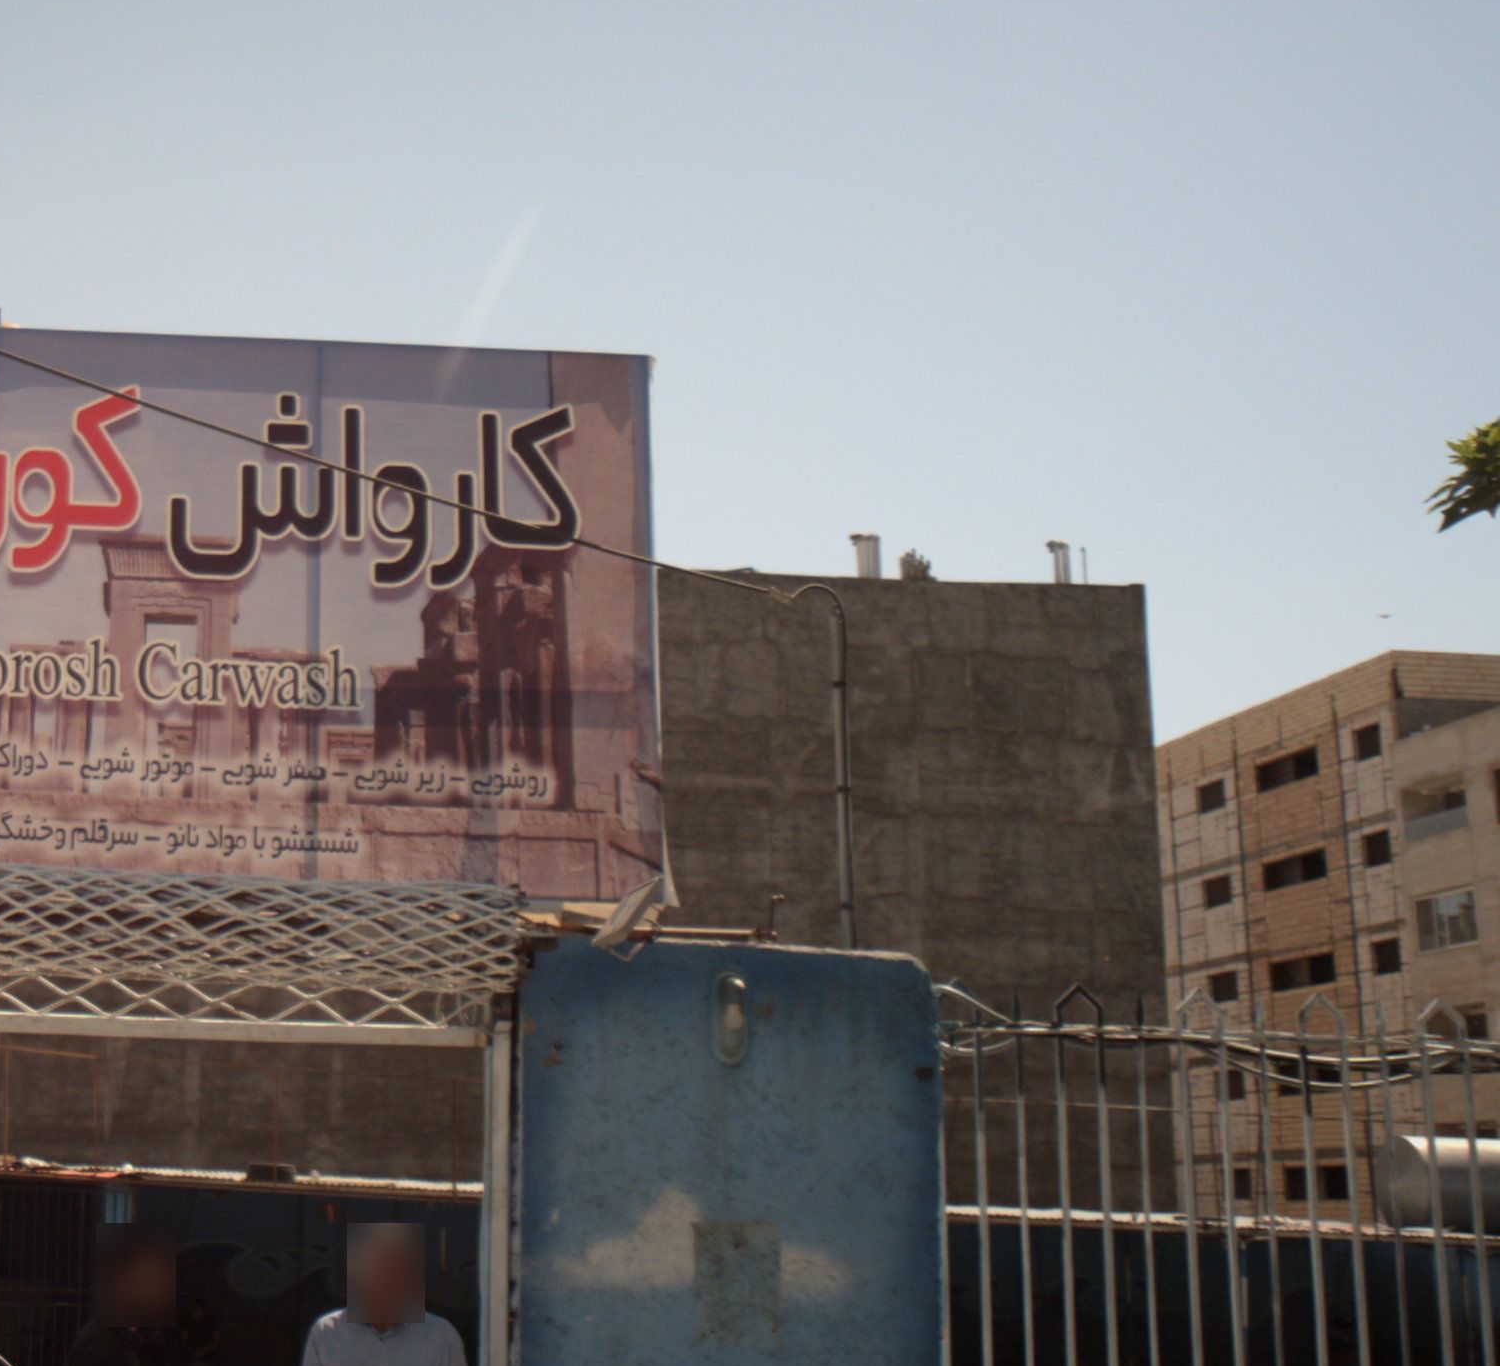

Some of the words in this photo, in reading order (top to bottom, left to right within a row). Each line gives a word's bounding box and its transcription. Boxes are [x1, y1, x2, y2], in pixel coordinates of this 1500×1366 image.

[166, 392, 578, 590] کارواش
[136, 639, 362, 708] Carwash
[140, 754, 194, 782] موتور
[415, 765, 446, 793] زیر
[70, 818, 138, 851] سرقلم
[166, 823, 199, 855] نانو
[206, 825, 247, 857] مواد
[254, 826, 266, 858] با
[271, 825, 359, 859] شستشو
